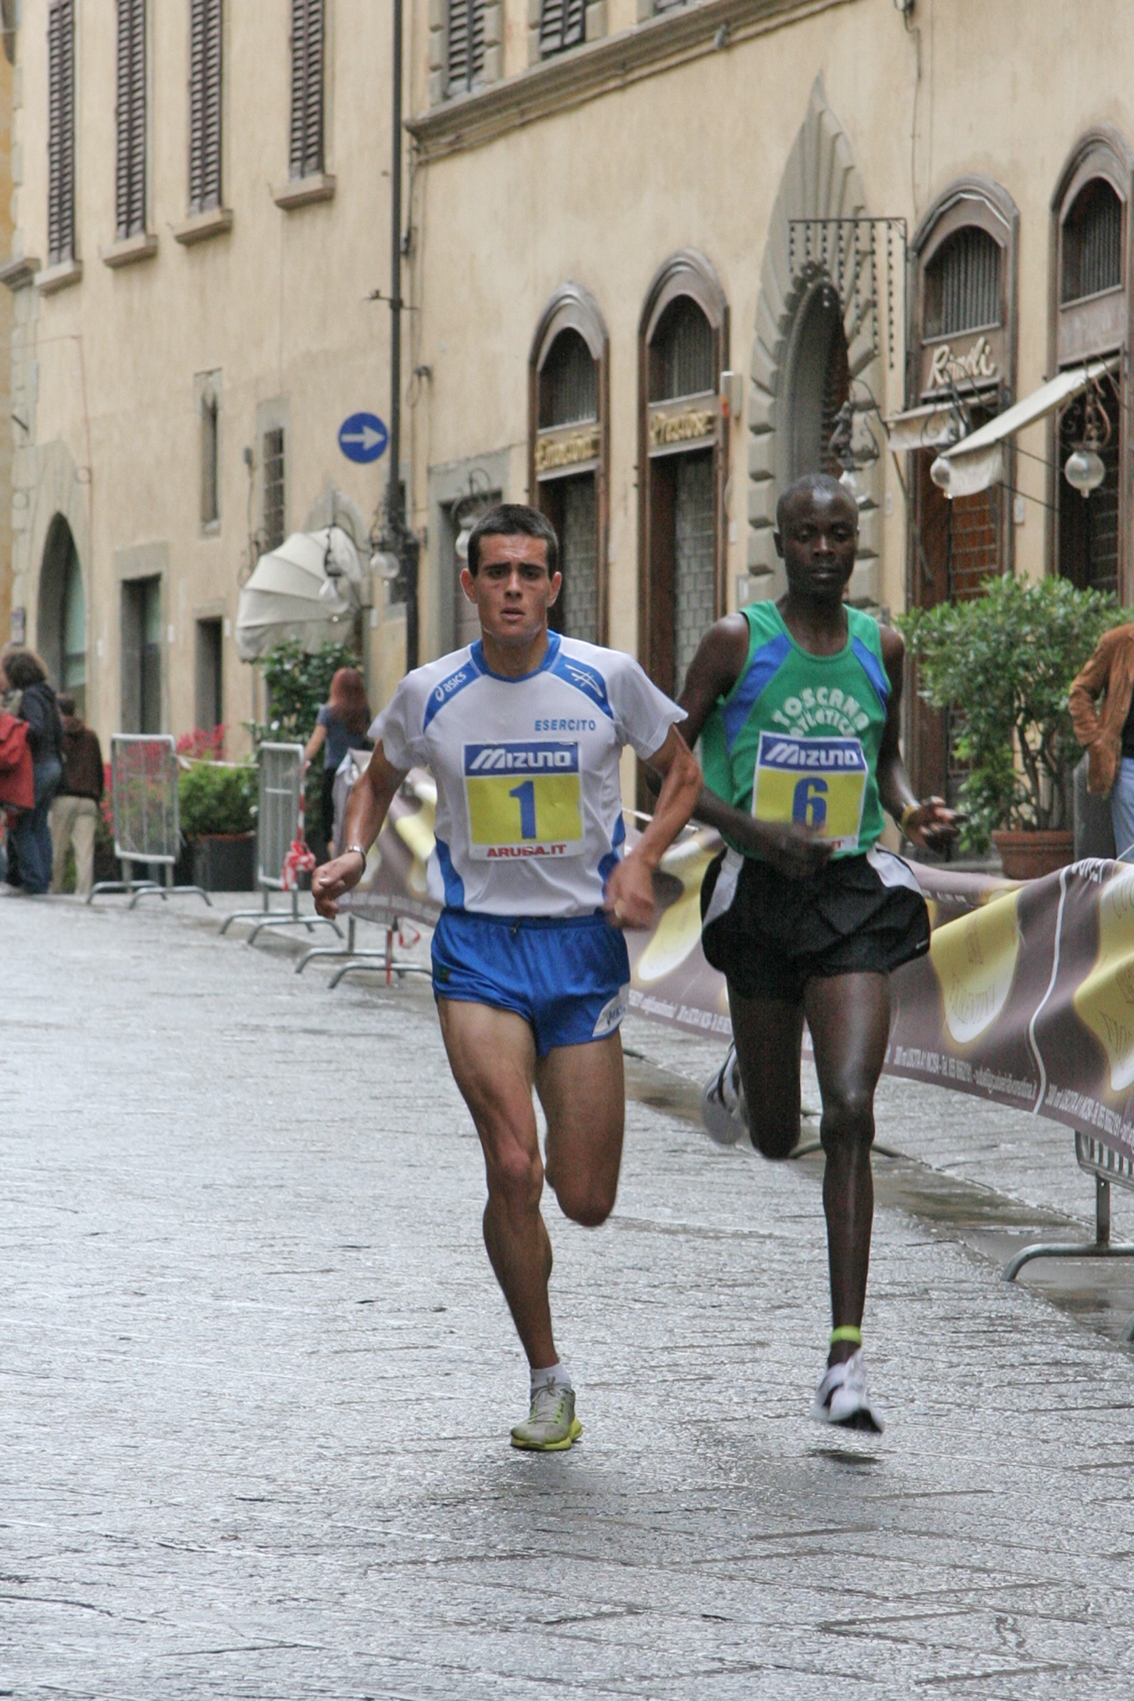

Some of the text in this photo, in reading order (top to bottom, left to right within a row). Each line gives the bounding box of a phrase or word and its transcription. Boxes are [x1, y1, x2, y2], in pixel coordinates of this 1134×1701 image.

[442, 671, 467, 692] asics
[534, 719, 596, 731] ESERCITO
[771, 686, 870, 731] TOSCANA
[509, 780, 536, 840] 1
[792, 777, 828, 831] 6
[487, 844, 567, 858] ARUBA.IT
